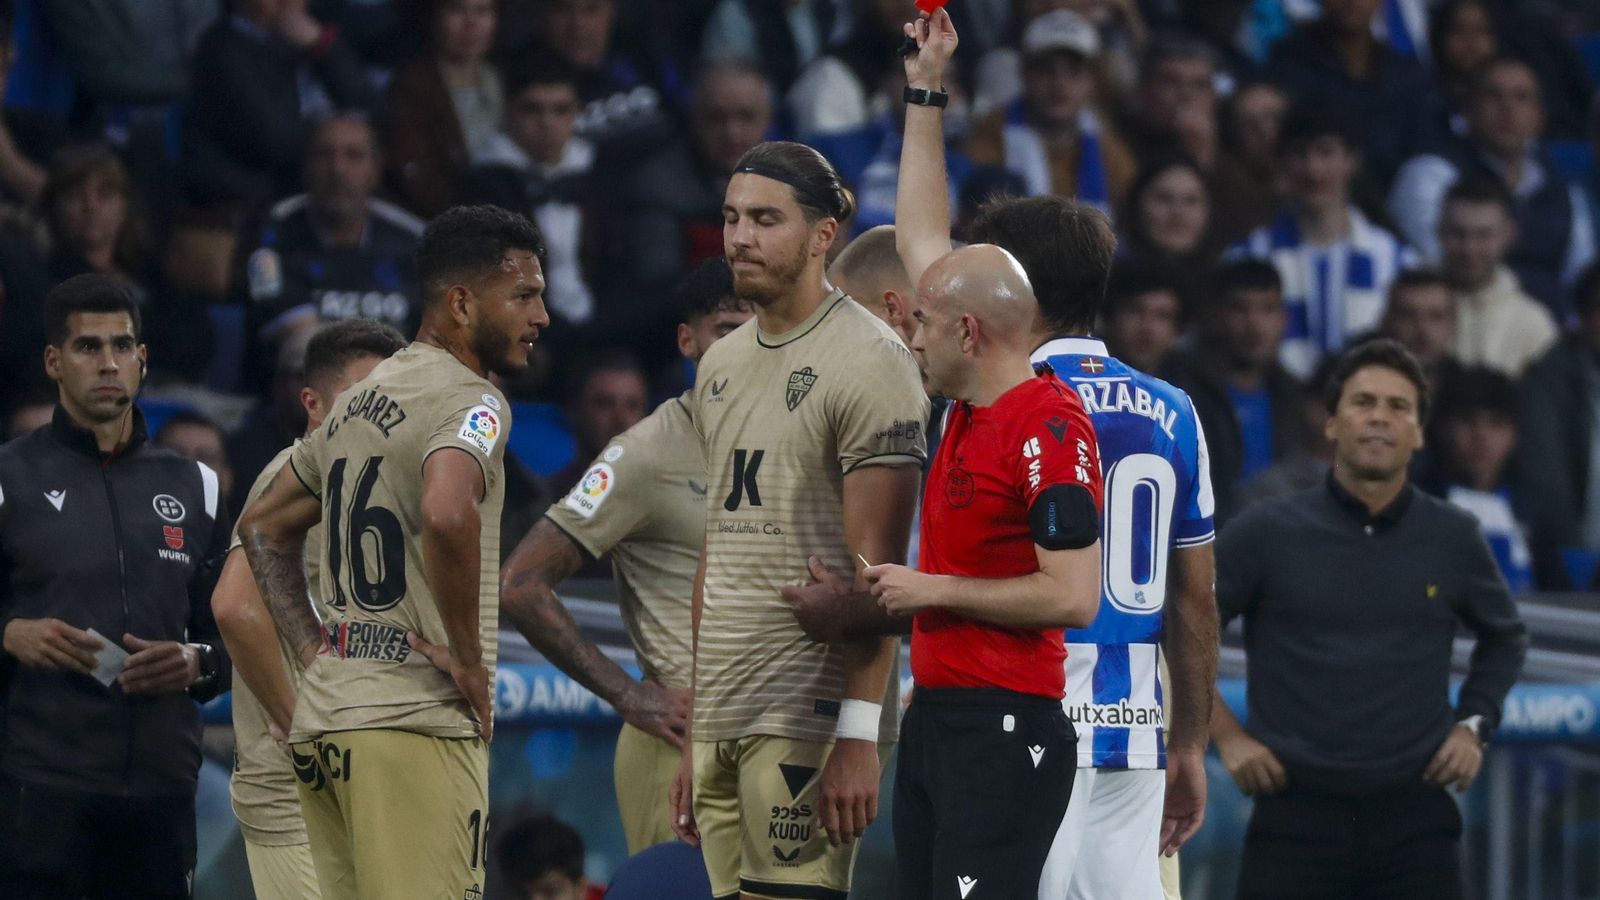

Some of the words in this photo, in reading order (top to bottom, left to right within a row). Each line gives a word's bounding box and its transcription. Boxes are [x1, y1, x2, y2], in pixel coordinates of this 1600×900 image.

[343, 385, 407, 440] SUÁREZ
[462, 429, 489, 453] LaLiga
[724, 448, 765, 512] JK
[325, 455, 408, 613] 16
[763, 523, 784, 535] Co.
[468, 809, 489, 873] 1
[768, 822, 811, 842] KUDU
